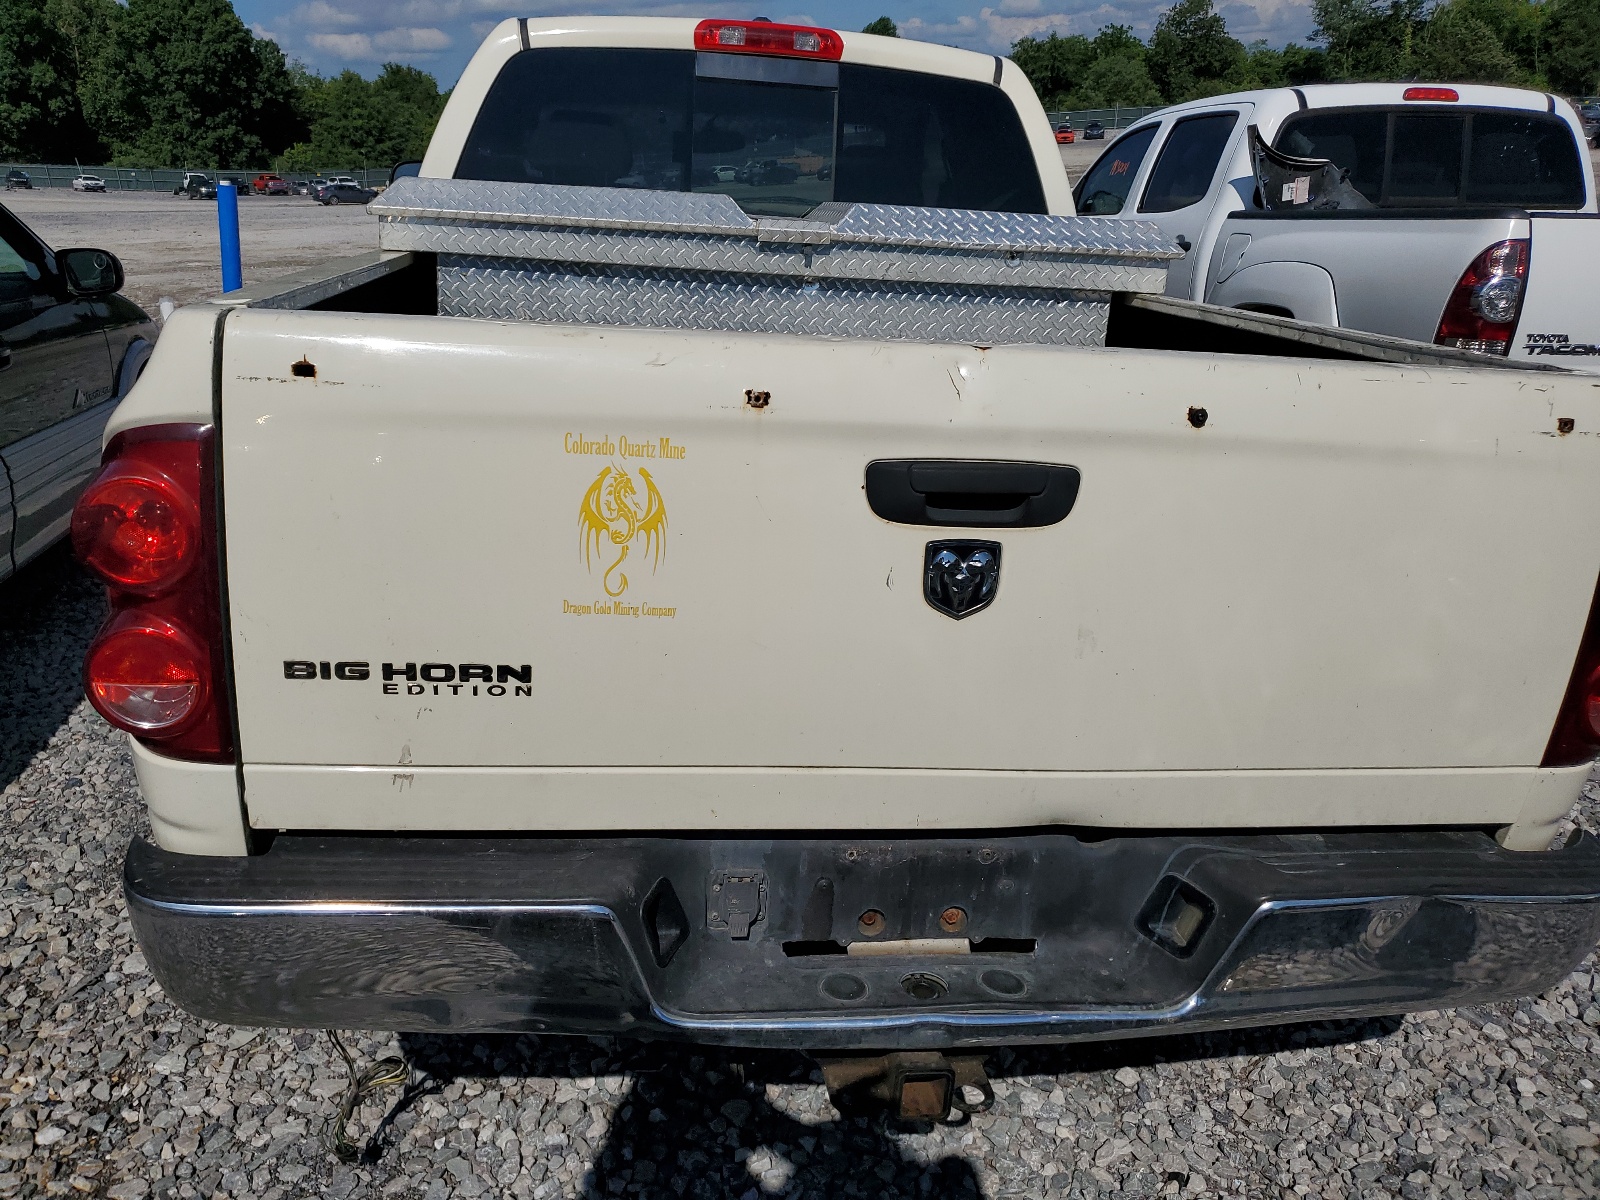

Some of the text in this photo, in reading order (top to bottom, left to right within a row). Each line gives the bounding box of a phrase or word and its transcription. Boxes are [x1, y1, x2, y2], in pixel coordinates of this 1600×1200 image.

[1526, 333, 1570, 344] TOYOTA
[564, 432, 686, 460] Colorado Quartz Mine
[563, 599, 592, 617] Dragon
[613, 601, 640, 619] Mining
[641, 601, 677, 619] Company
[283, 660, 533, 684] BIG HORN
[382, 683, 532, 697] EDITION
